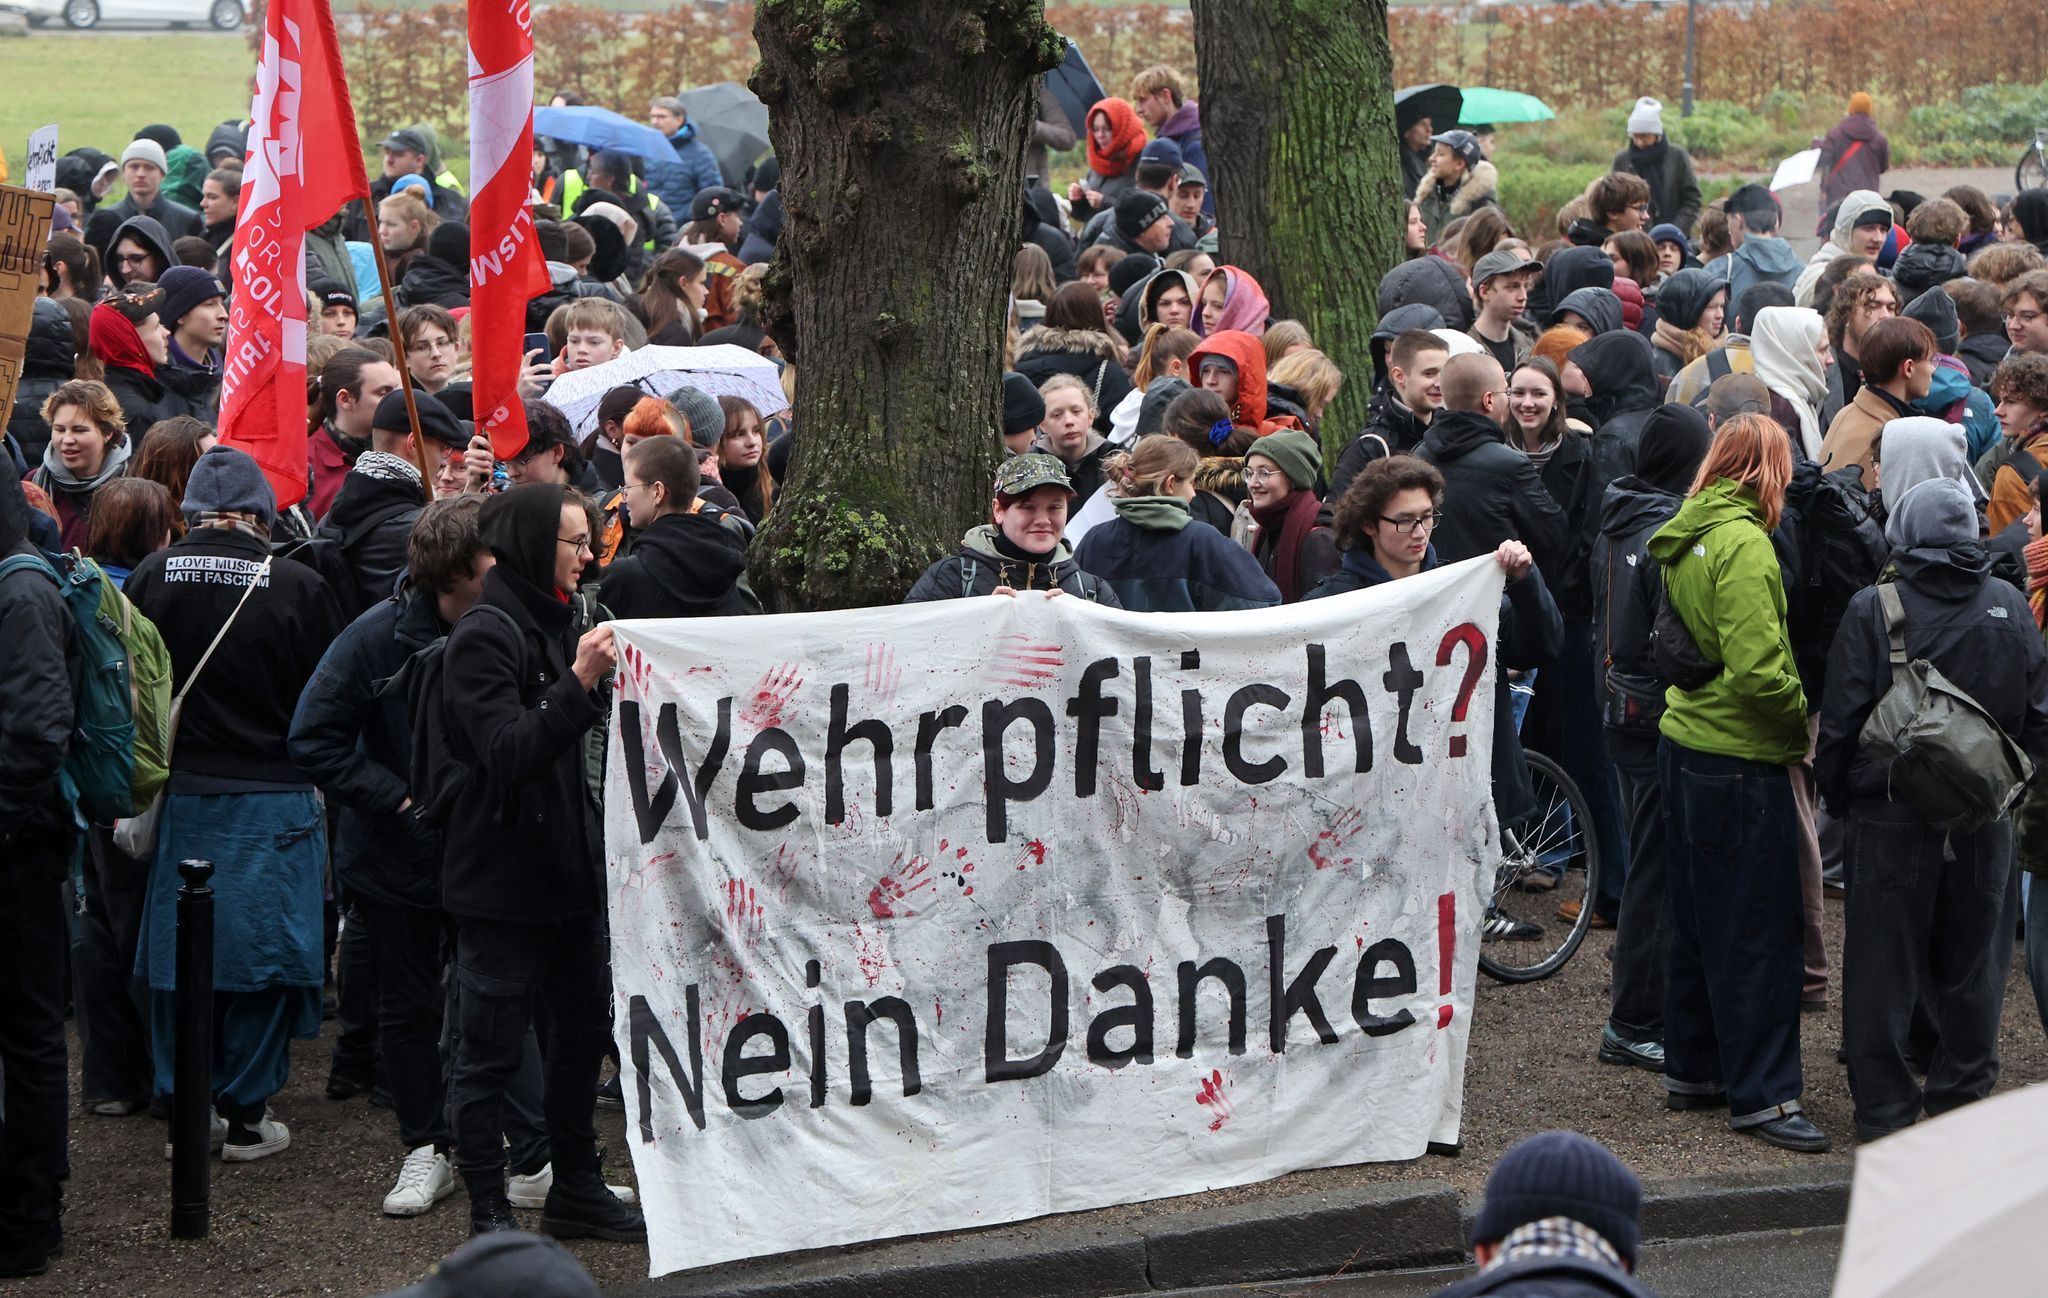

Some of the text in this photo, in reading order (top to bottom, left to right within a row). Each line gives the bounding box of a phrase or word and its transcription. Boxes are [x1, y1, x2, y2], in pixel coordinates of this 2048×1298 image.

[164, 570, 270, 588] HATE FASCISM
[175, 557, 261, 573] LOVE MUSIC
[619, 621, 1487, 845] Wehrpflicht?
[628, 890, 1456, 1144] Nein Danke!
